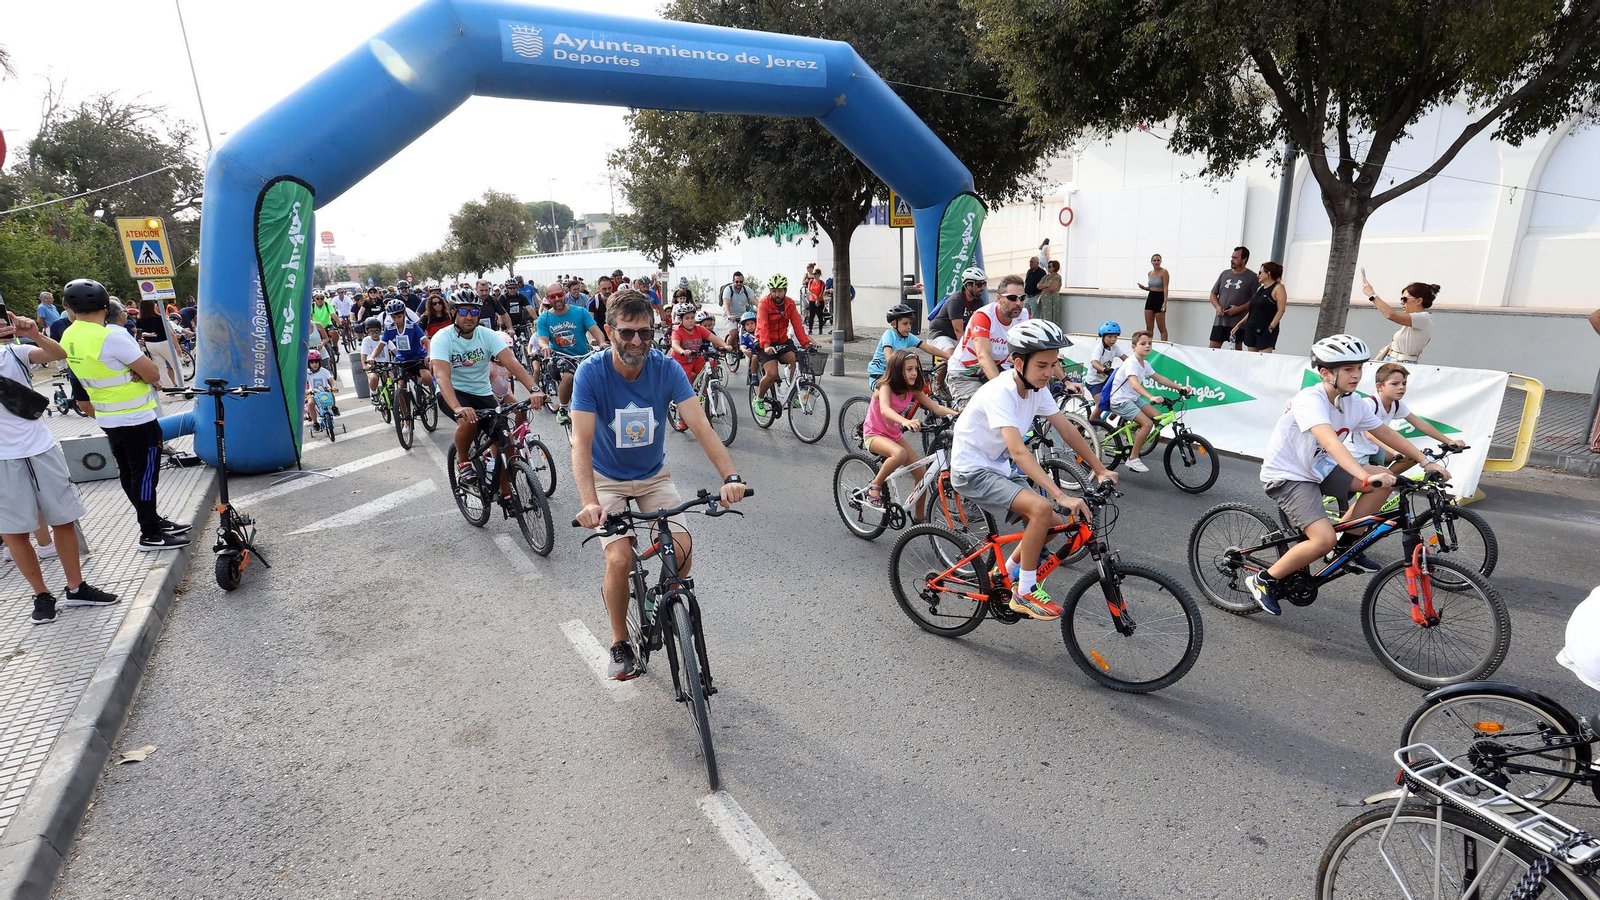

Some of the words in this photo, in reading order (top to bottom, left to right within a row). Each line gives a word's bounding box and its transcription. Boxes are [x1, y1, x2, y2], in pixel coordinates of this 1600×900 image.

[553, 32, 729, 62] Ayuntamiento
[734, 52, 760, 65] de
[766, 54, 818, 69] Jerez
[553, 49, 640, 66] Deportes
[893, 217, 913, 225] PEATONES
[951, 211, 976, 262] Inglés
[134, 266, 170, 275] PEATONES
[1036, 559, 1055, 577] WIN
